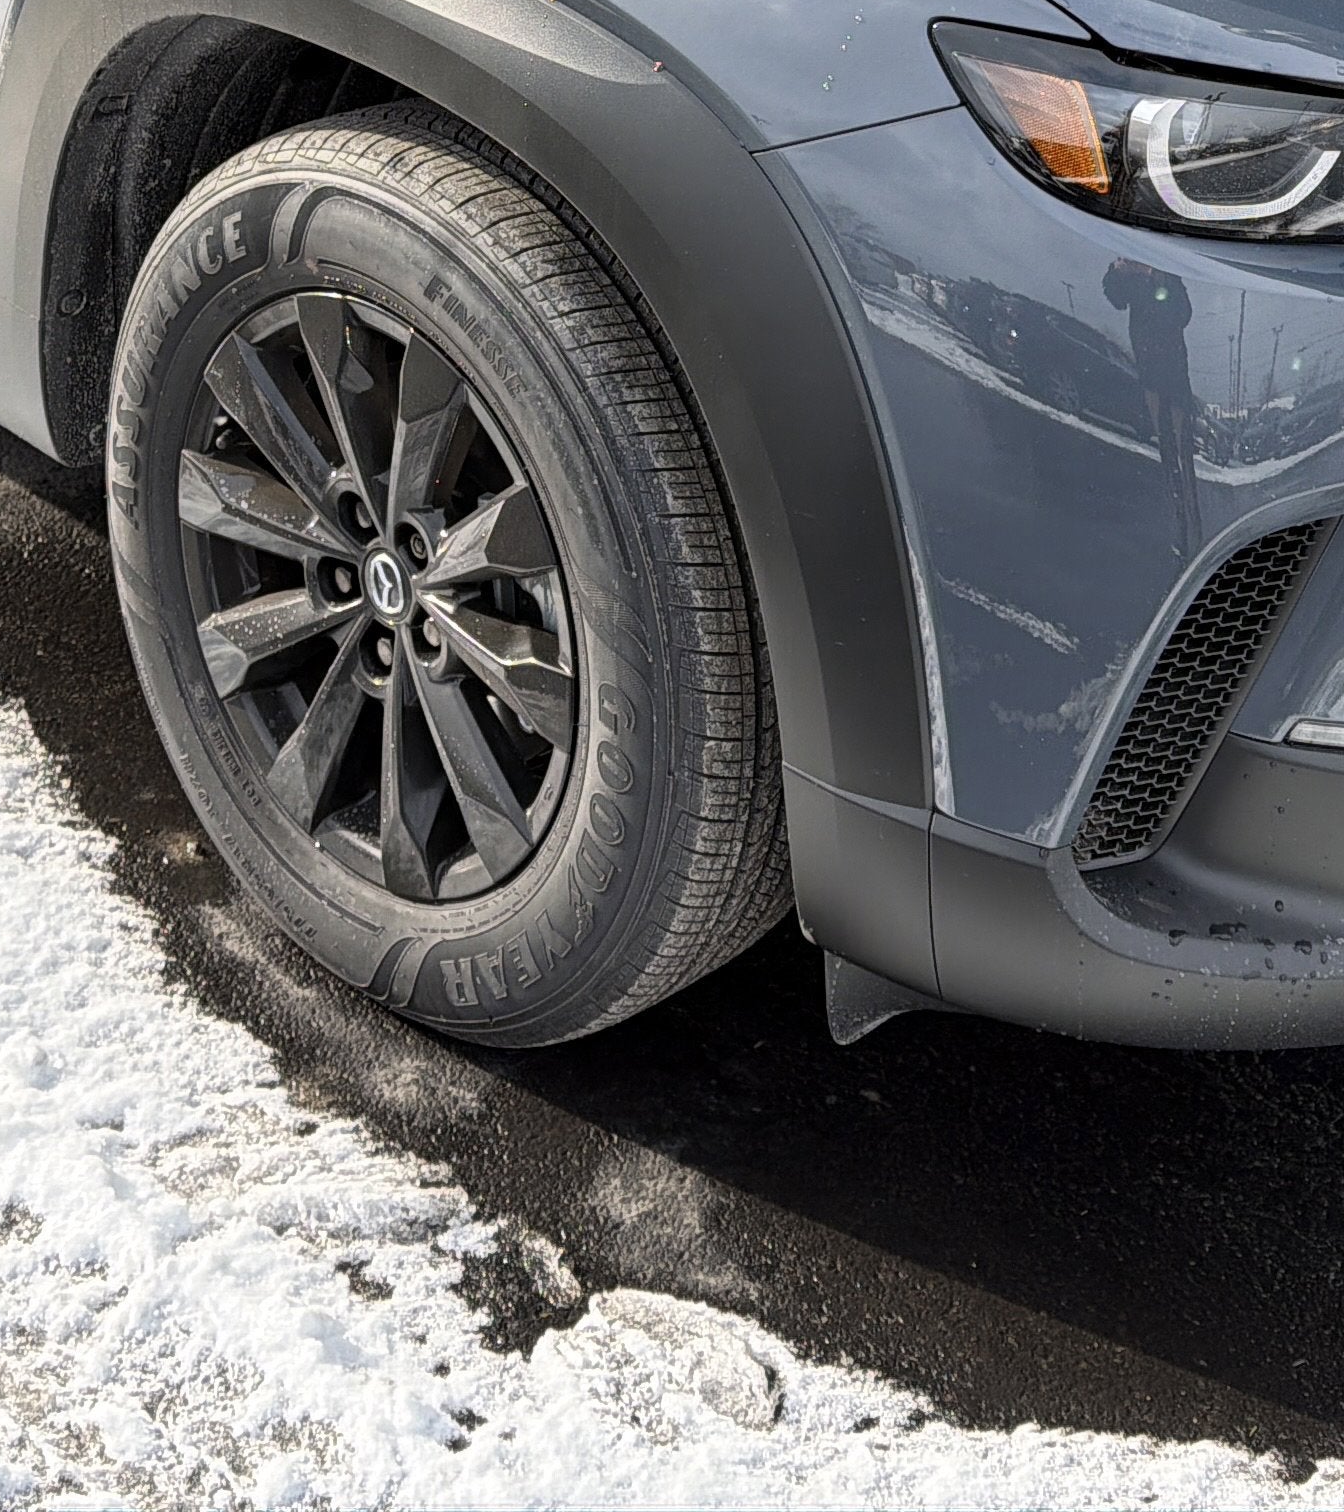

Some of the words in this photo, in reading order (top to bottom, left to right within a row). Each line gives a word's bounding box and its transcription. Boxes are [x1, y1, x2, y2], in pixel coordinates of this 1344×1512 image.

[112, 210, 248, 531] ASSURANCE
[422, 273, 528, 399] FINESSE
[439, 681, 637, 1007] GOODYEAR
